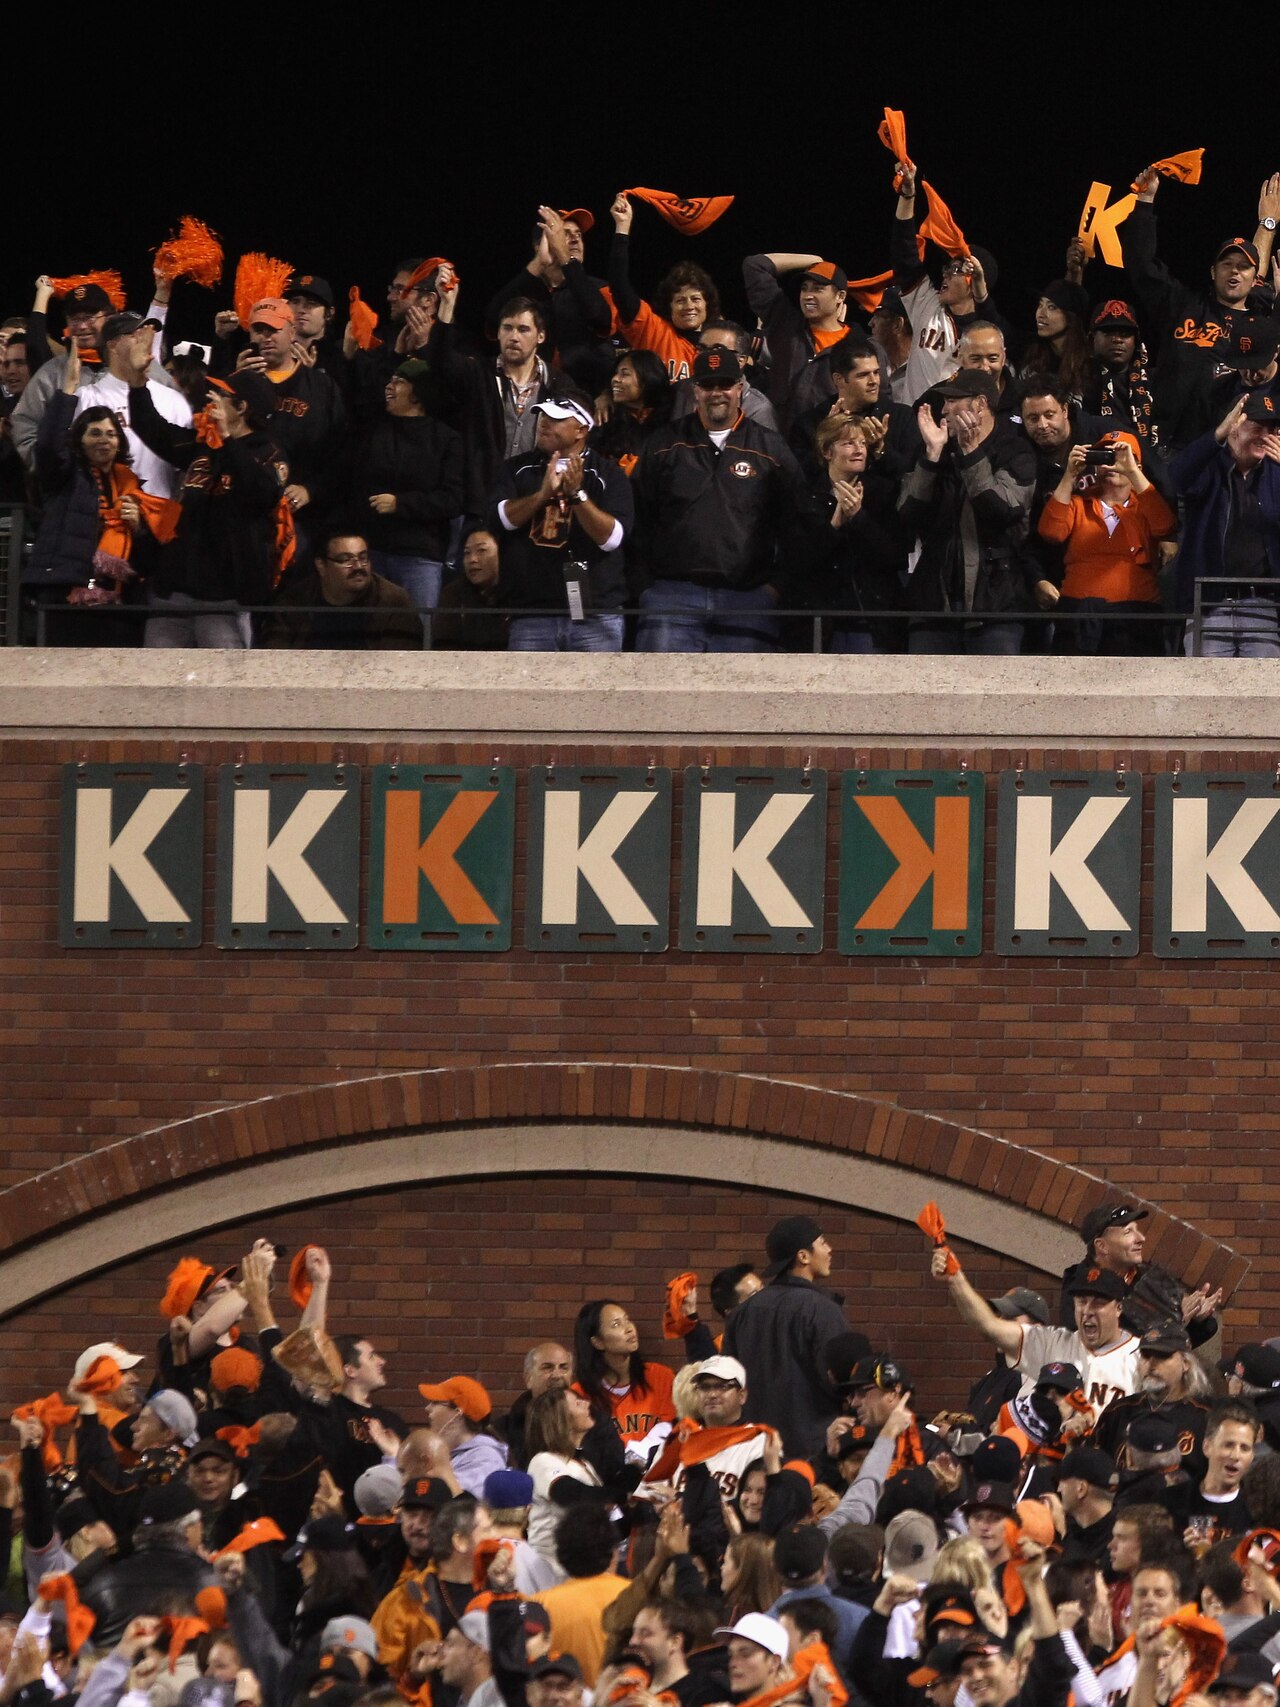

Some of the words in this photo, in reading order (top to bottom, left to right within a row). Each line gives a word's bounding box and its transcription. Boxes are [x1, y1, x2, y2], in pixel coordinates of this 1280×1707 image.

[1077, 181, 1138, 268] K
[74, 788, 190, 922] K
[232, 789, 348, 923] K
[384, 790, 499, 924] K
[542, 790, 658, 925] K
[697, 791, 813, 927] K
[1015, 795, 1131, 930] K
